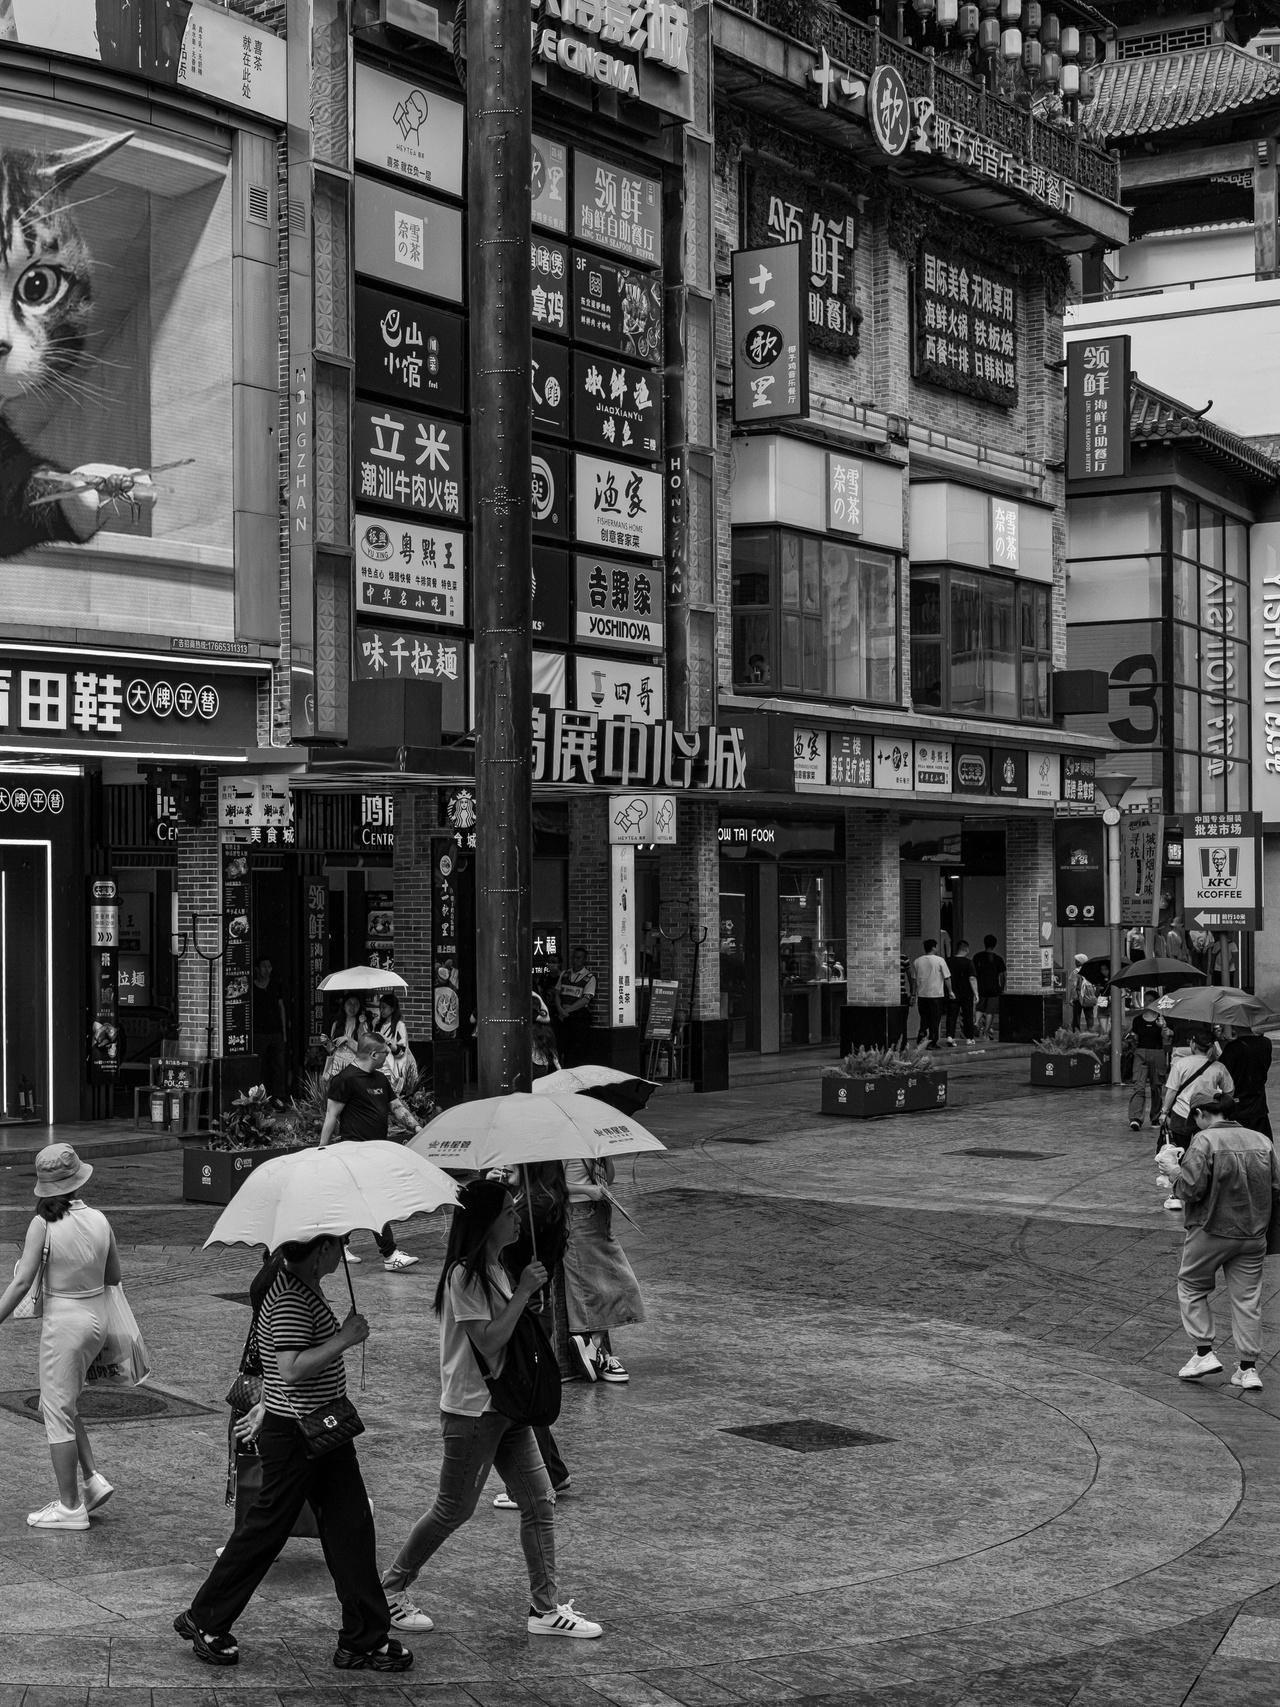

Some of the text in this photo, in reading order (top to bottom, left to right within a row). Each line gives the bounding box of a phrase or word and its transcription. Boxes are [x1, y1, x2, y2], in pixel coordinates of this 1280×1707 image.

[242, 35, 252, 99] 就在此处
[254, 40, 263, 71] 喜茶
[557, 38, 640, 97] CINEMA
[933, 114, 1075, 213] 椰子鸡音乐主题餐厅
[594, 167, 642, 223] 领鲜
[581, 204, 655, 251] 海鲜自助餐厅
[609, 238, 633, 253] SEAFOOD
[576, 257, 587, 271] 3F
[924, 252, 1013, 323] 国际美食 无限享用
[924, 299, 1014, 357] 海鲜火锅 铁板烧
[925, 334, 1015, 389] 西餐牛排 日韩料理
[1083, 345, 1110, 396] 领鲜
[596, 402, 643, 422] JIAOXIANYU
[370, 413, 451, 472] 立米
[1094, 399, 1108, 472] 海鲜自助餐厅
[295, 368, 307, 533] HONGZHAN
[360, 461, 460, 514] 潮汕牛肉火锅
[594, 470, 647, 518] 渔家
[597, 516, 644, 534] FISHERMANS HOME
[600, 528, 640, 549] 创意客家菜
[375, 551, 389, 559] XING
[361, 566, 385, 580] 特色点心
[366, 584, 442, 612] 中华名小吃
[588, 565, 652, 617] 吉野家
[589, 616, 651, 642] YOSHINOYA
[172, 638, 248, 654] 广告招商热线:17665311313
[129, 682, 217, 716] 大牌平替
[613, 676, 655, 716] 四哥
[1108, 653, 1159, 744] 3
[841, 736, 862, 756] 三楼
[1195, 815, 1242, 823] 中国专业服装
[1195, 823, 1242, 836] 批发市场
[250, 827, 295, 843] 美食城
[733, 828, 748, 841] TAI
[751, 829, 775, 843] FOOK
[1130, 833, 1140, 859] 寻找
[1197, 890, 1242, 899] KCOFFEE
[1207, 878, 1232, 887] KFC
[308, 884, 325, 940] 领鲜
[533, 936, 557, 955] 大福
[439, 1140, 472, 1149] 伟星管
[602, 1125, 631, 1136] 伟星管
